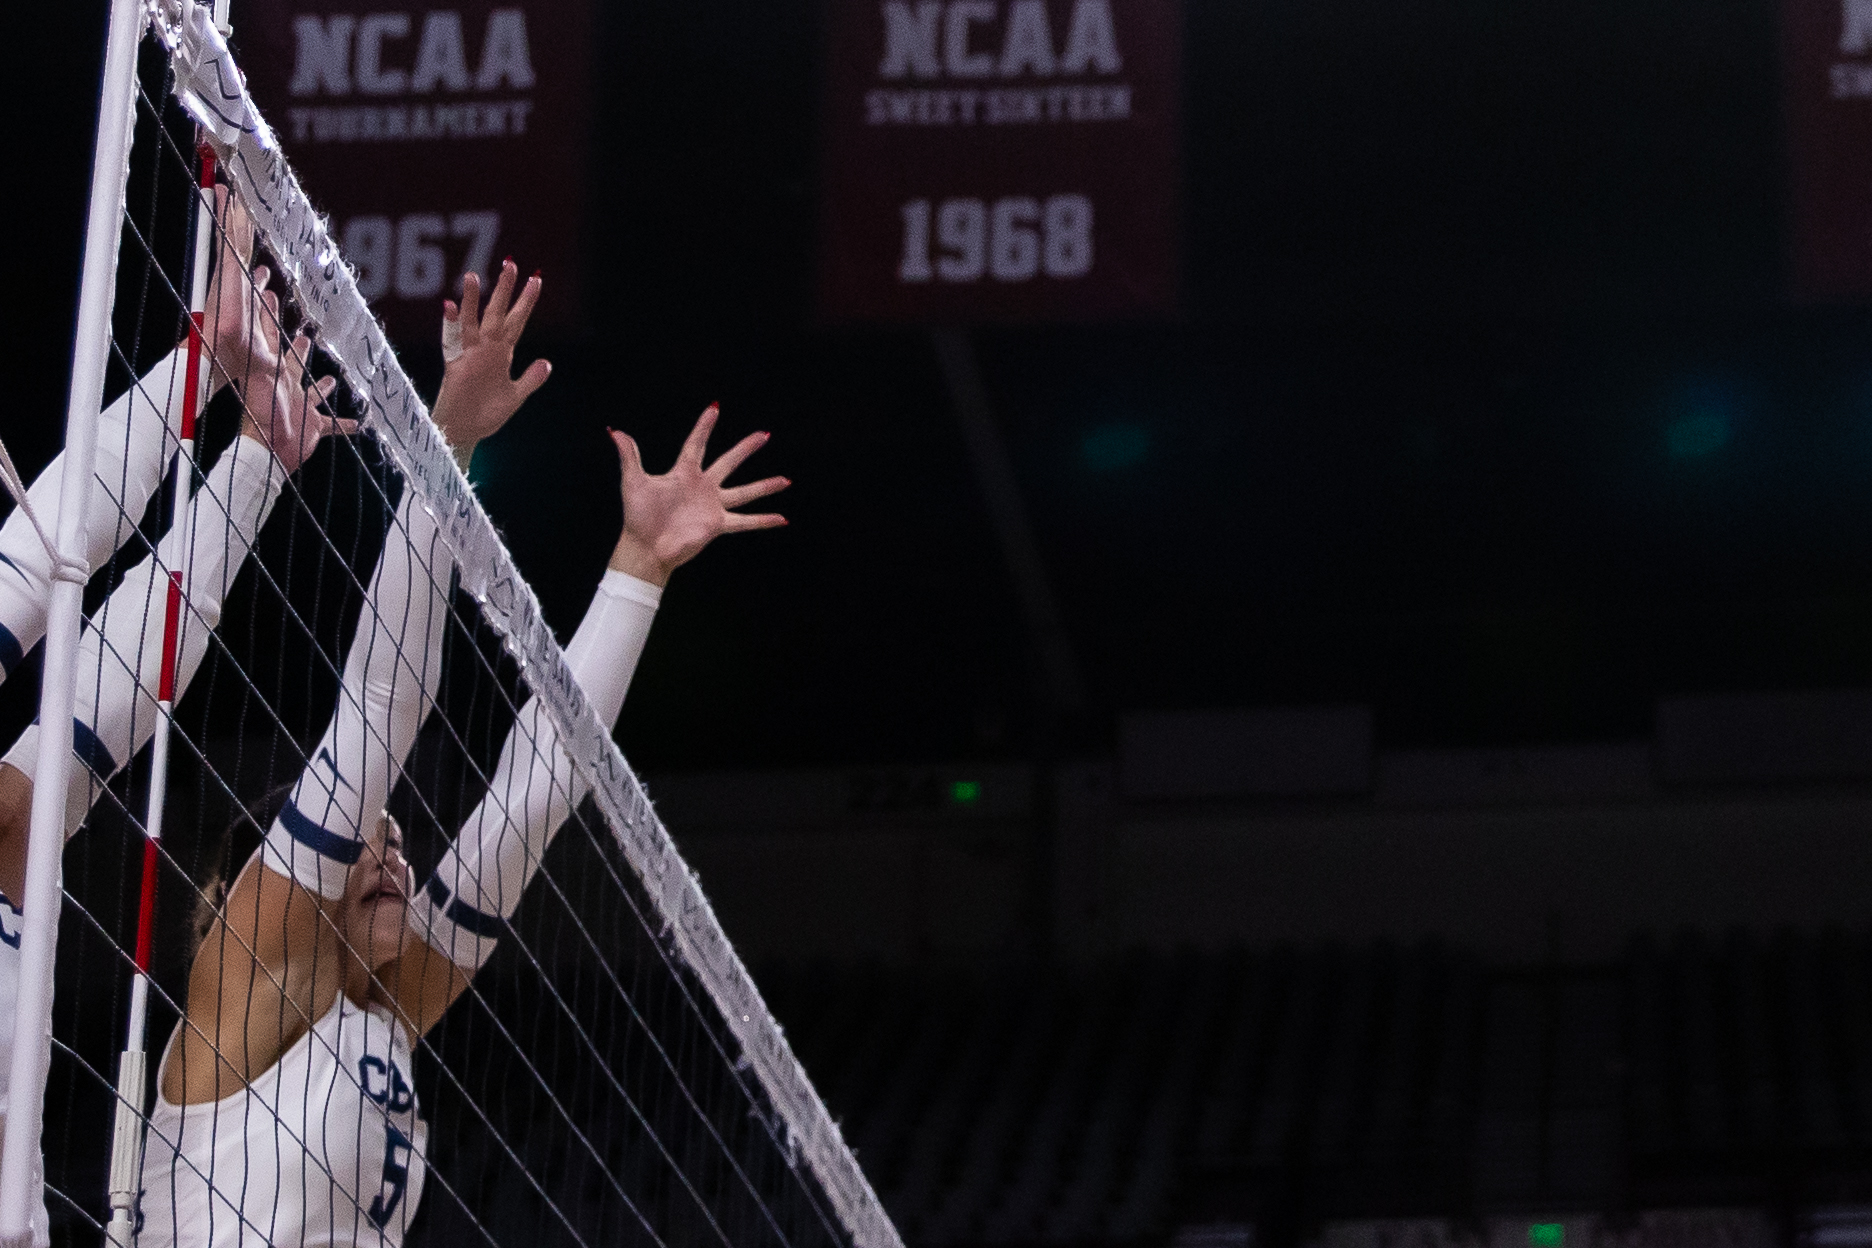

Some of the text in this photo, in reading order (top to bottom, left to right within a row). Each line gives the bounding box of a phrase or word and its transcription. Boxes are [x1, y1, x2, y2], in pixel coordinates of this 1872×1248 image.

[290, 9, 536, 95] NCAA
[289, 100, 533, 141] TOURNAMENT
[865, 85, 1132, 125] SWEET SIXTEEN
[338, 209, 499, 300] 967
[898, 195, 1093, 283] 1968
[367, 1126, 413, 1230] 5
